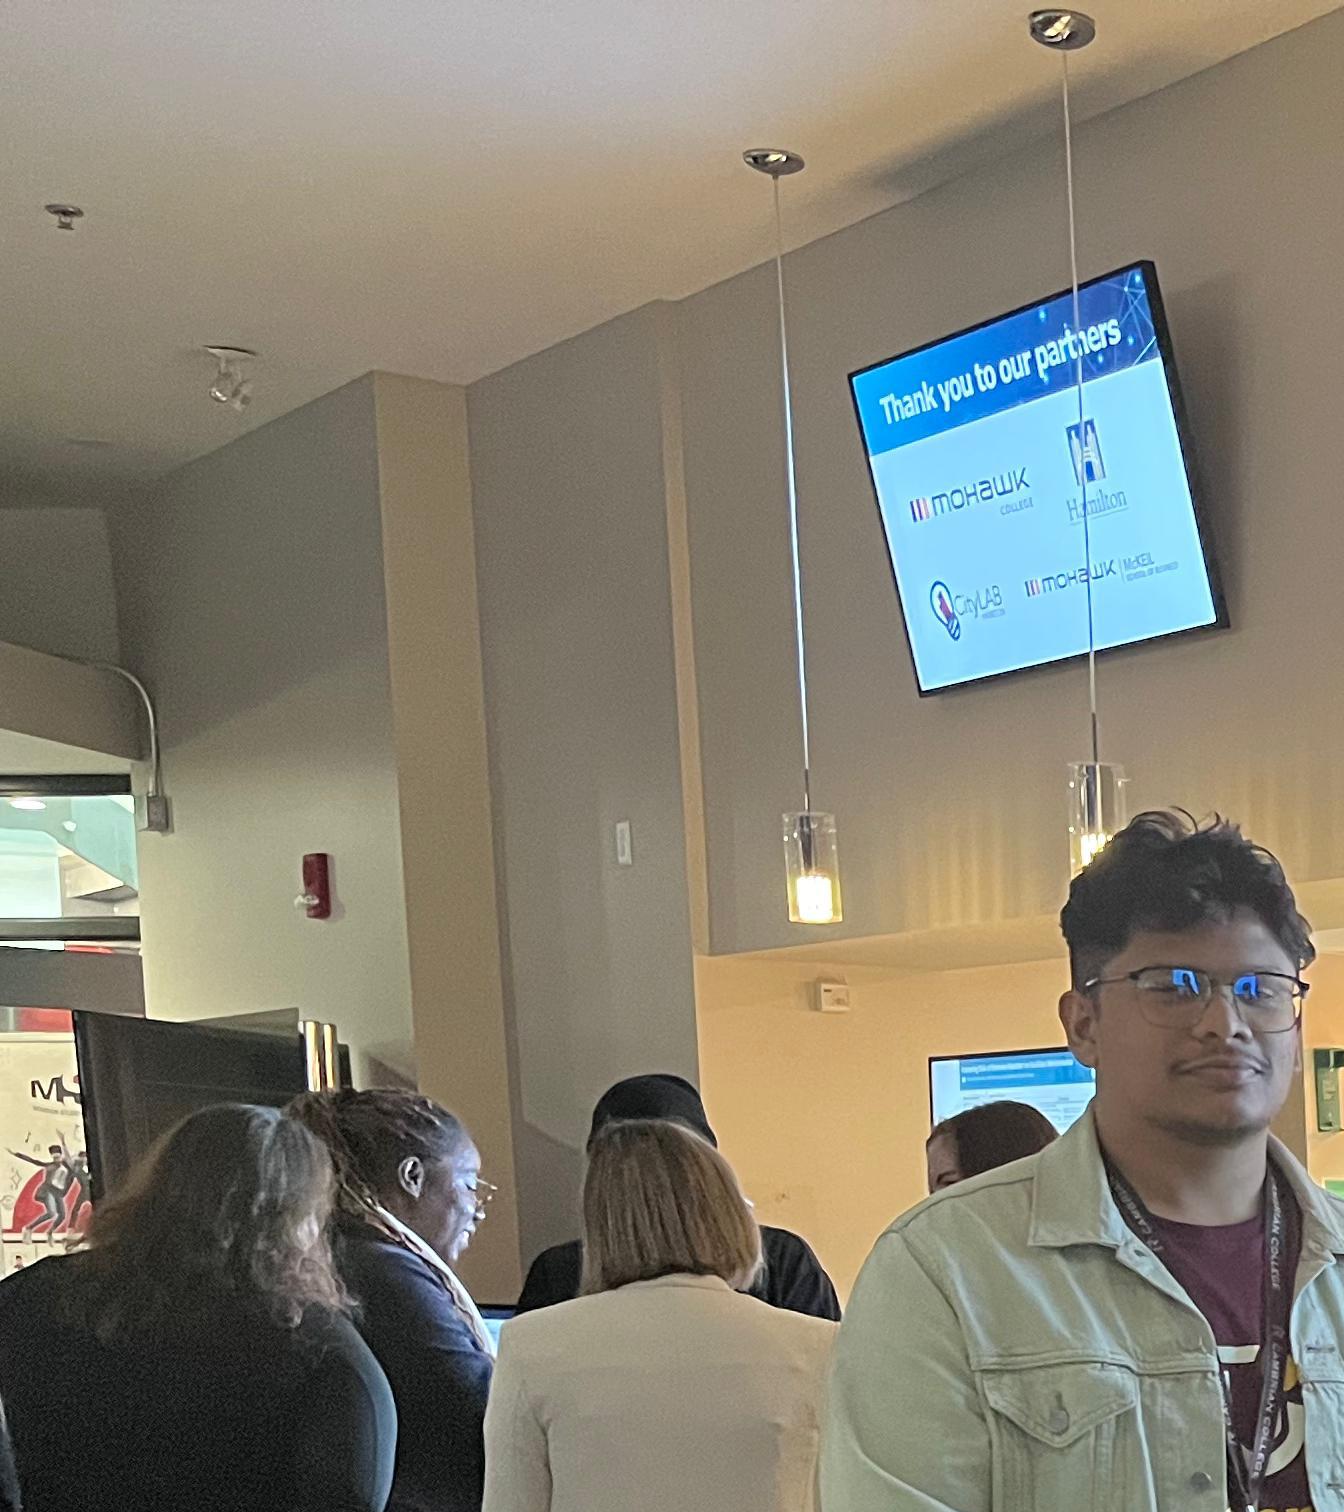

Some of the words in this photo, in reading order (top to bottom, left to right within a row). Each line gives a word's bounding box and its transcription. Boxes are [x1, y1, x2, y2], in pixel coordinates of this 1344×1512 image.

[880, 381, 939, 425] Thank
[937, 372, 974, 412] you
[973, 362, 998, 393] to
[999, 350, 1032, 385] our
[1034, 318, 1122, 375] partners
[955, 584, 1003, 619] CityLAB
[1265, 1343, 1282, 1414] CAMBRIAN
[1250, 1415, 1273, 1480] COLLEGE
